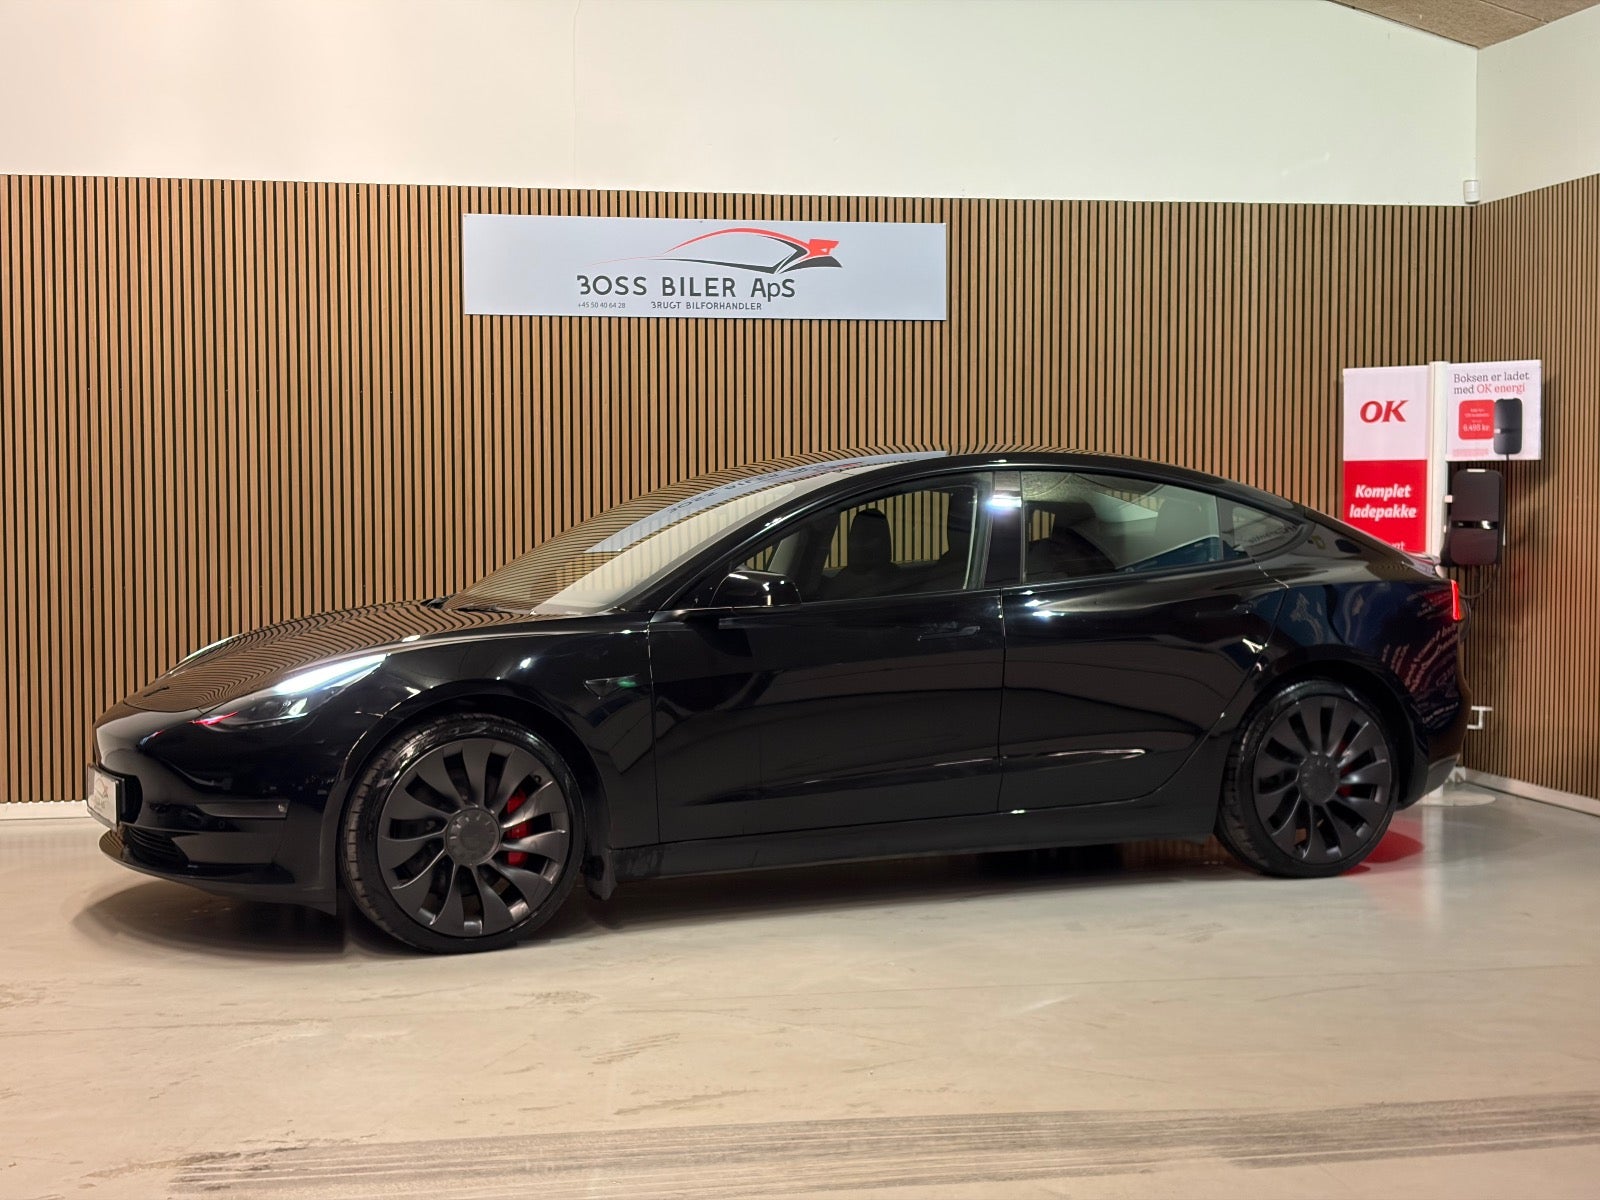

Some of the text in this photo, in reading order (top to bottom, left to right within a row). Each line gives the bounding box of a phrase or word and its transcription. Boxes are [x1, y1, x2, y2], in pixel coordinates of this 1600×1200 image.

[662, 276, 736, 297] BILER
[750, 277, 796, 302] ApS
[590, 301, 599, 309] 50
[686, 301, 762, 311] BILFORHANDLER
[1453, 371, 1530, 384] Boksen er ladet
[1453, 384, 1526, 395] med OK energi
[1359, 399, 1409, 423] OK
[1355, 483, 1411, 502] Komplet
[1349, 504, 1417, 522] ladepakke
